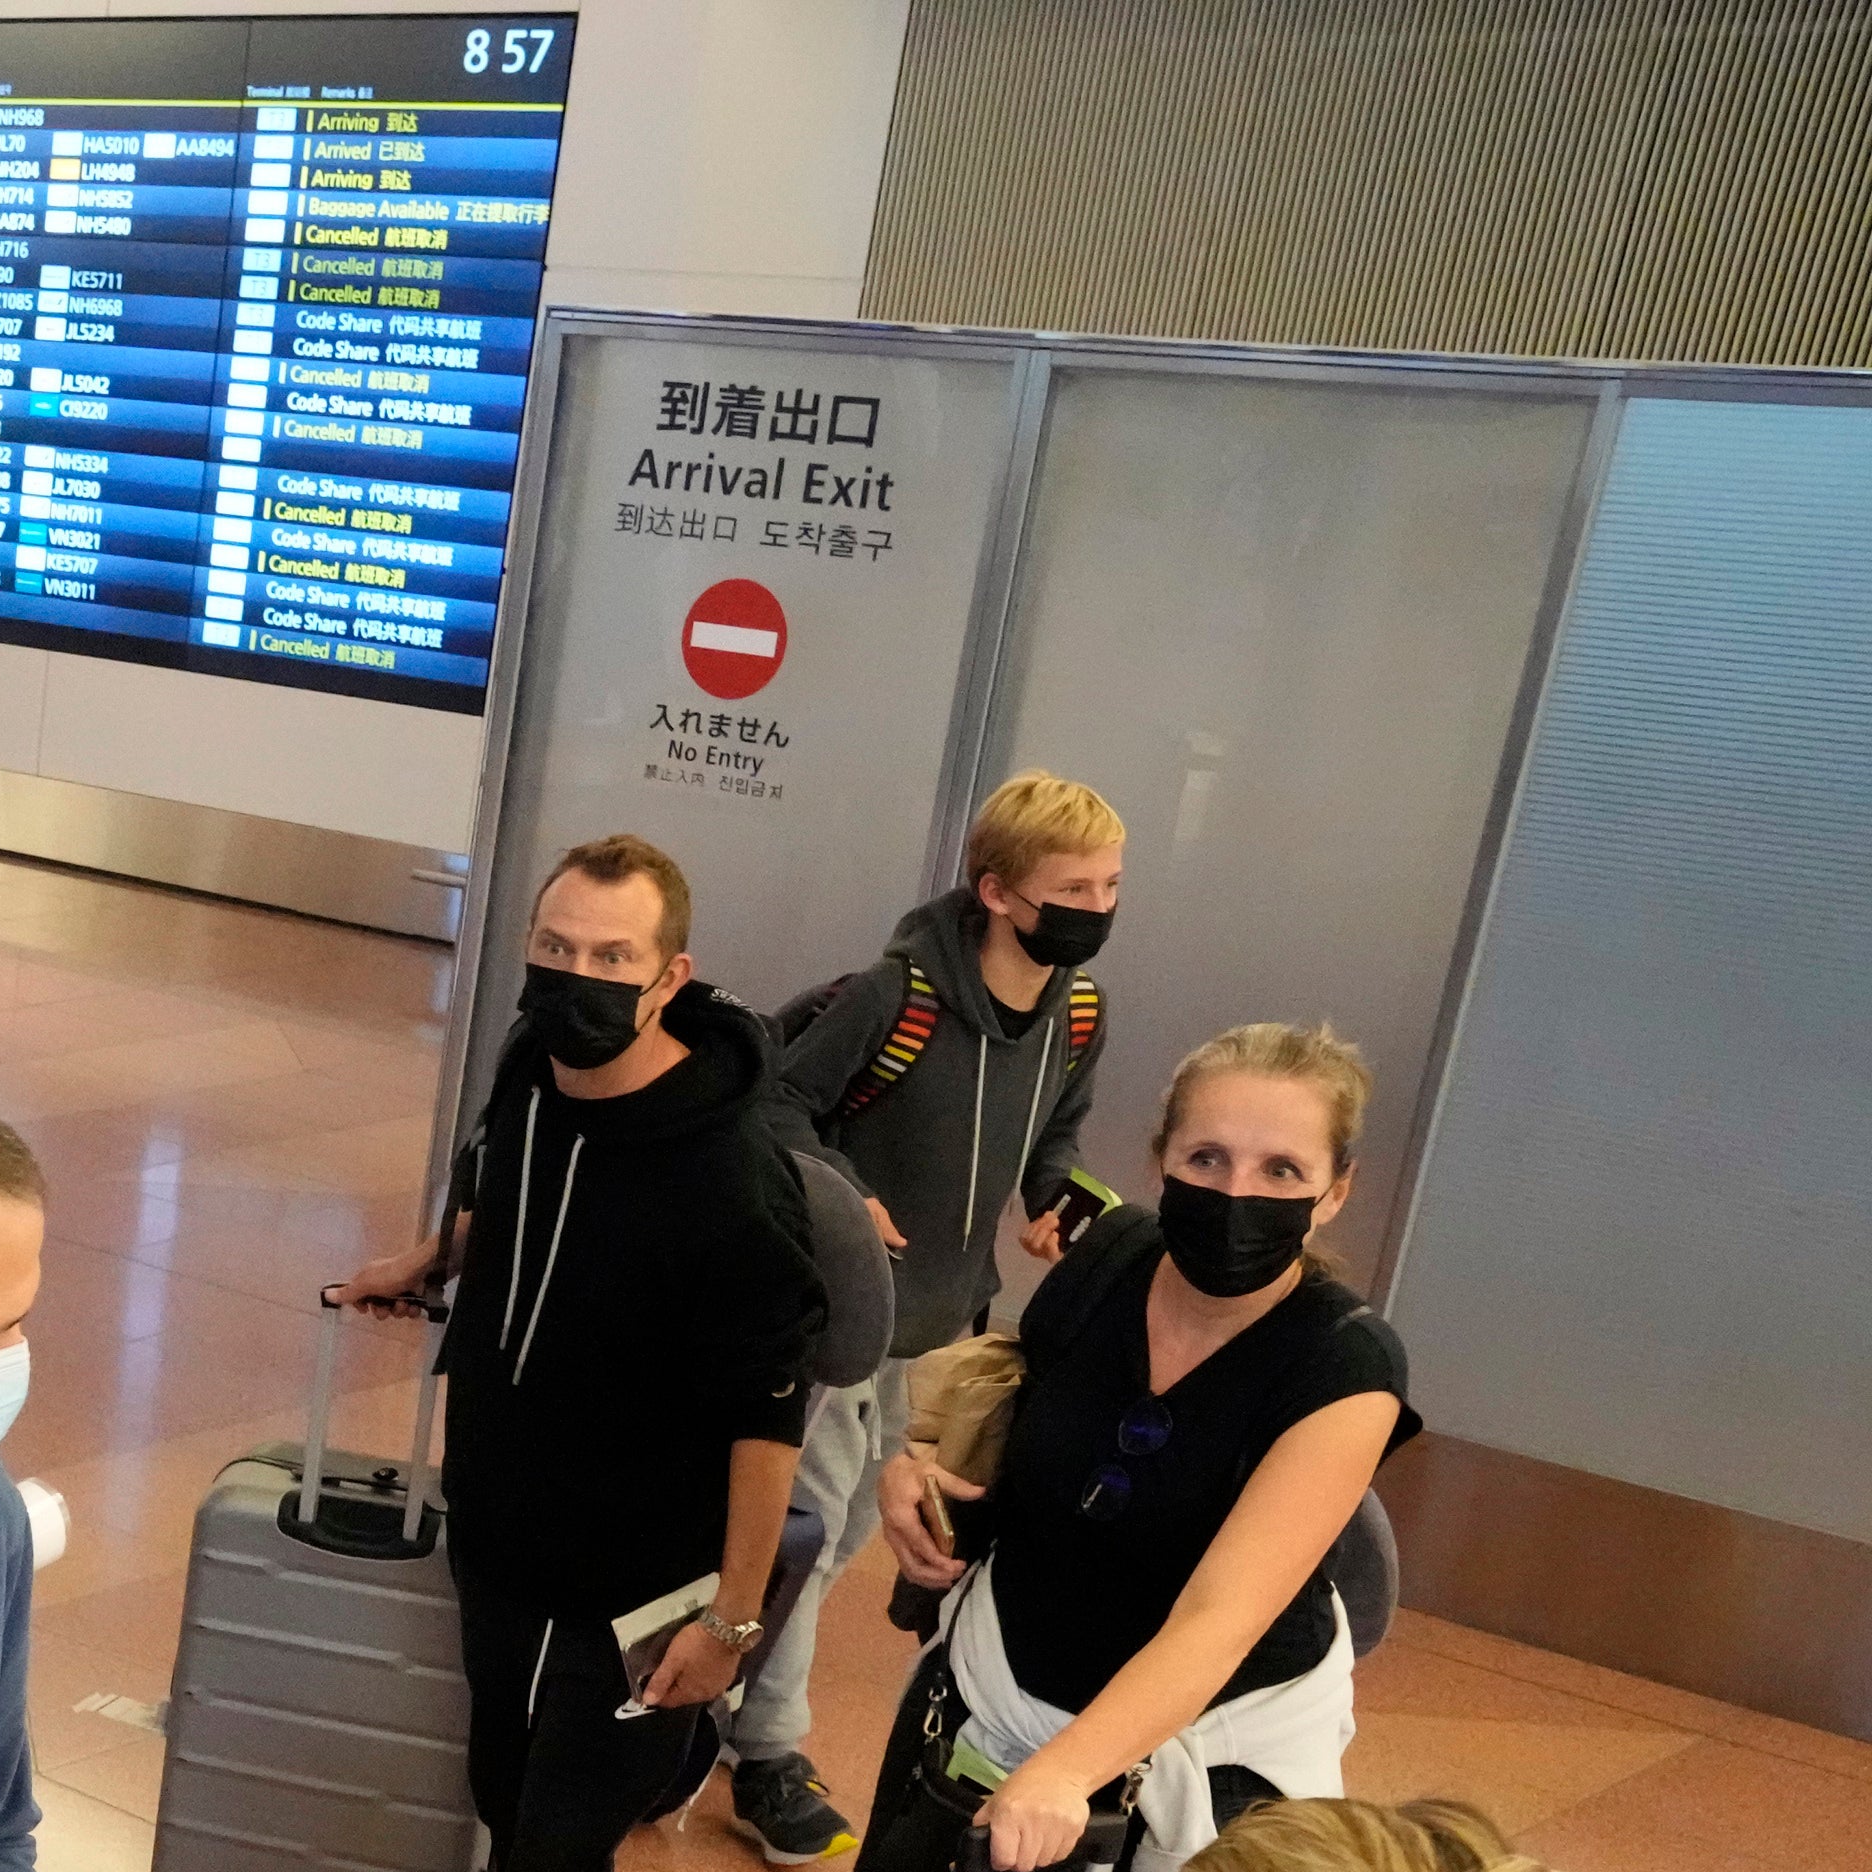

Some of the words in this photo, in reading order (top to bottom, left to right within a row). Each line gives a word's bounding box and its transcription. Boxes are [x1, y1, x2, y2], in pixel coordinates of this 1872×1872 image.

[463, 29, 490, 74] 8
[501, 29, 555, 74] 57
[318, 112, 380, 134] Arriving
[386, 112, 418, 133] 到达
[84, 136, 139, 154] HA5010
[314, 140, 372, 160] Arrived
[311, 169, 373, 191] Arriving
[380, 169, 412, 190] 到达
[308, 197, 376, 220] Baggage
[378, 199, 450, 220] Available
[306, 224, 378, 246] Cancelled
[303, 254, 376, 276] Cancelled
[71, 270, 123, 290] KE5711
[300, 283, 372, 305] Cancelled
[296, 310, 336, 331] Code
[338, 312, 383, 333] Share
[293, 338, 333, 358] Code
[336, 340, 380, 361] Share
[290, 366, 362, 388] Cancelled
[287, 392, 328, 413] Code
[330, 394, 374, 417] Share
[656, 381, 882, 448] 到着出口
[284, 419, 356, 442] Cancelled
[278, 474, 317, 497] Code
[320, 478, 363, 501] Share
[629, 449, 783, 500] Arrival
[802, 464, 895, 513] Exit
[275, 501, 346, 526] Cancelled
[272, 528, 312, 550] Code
[313, 532, 356, 555] Share
[615, 503, 738, 543] 到达出口
[759, 521, 894, 563] 도착출구
[269, 554, 340, 580] Cancelled
[266, 580, 305, 603] Code
[307, 584, 350, 608] Share
[263, 607, 302, 630] Code
[304, 612, 347, 636] Share
[261, 632, 330, 660] Cancelled
[649, 703, 790, 748] 入れません
[668, 740, 697, 762] No
[706, 745, 764, 777] Entry
